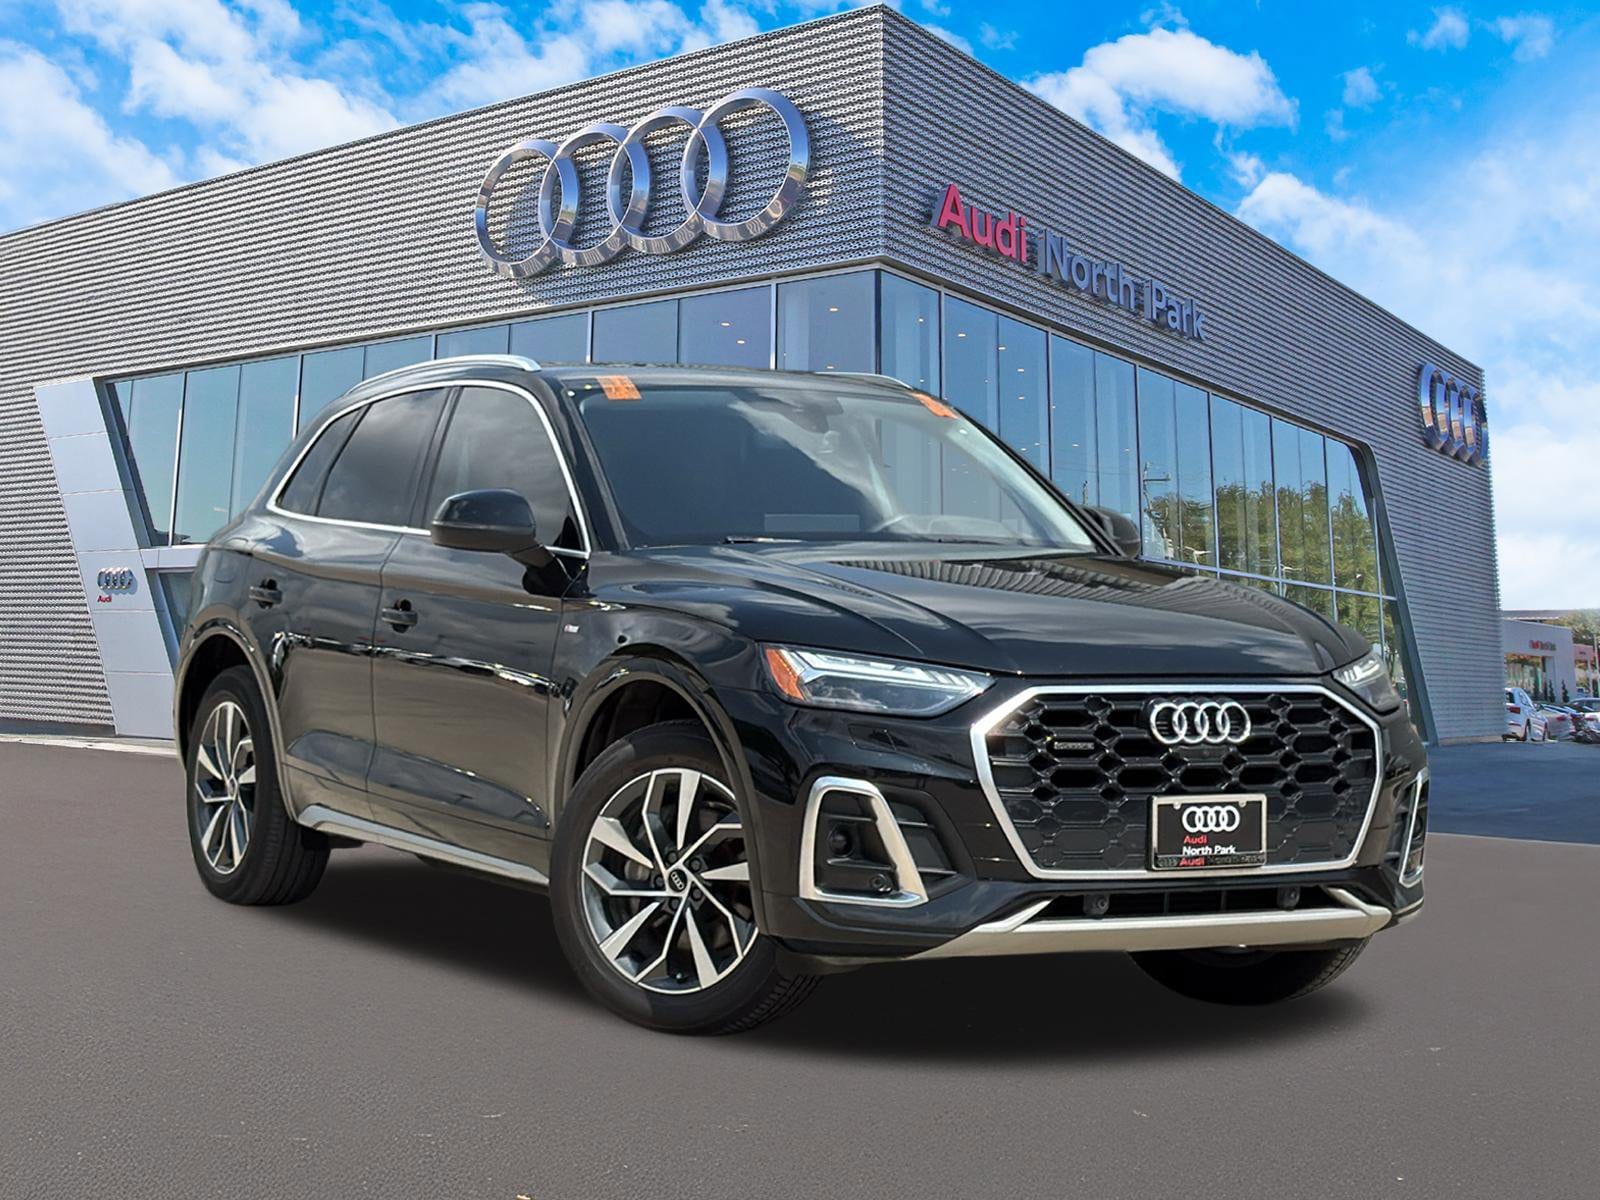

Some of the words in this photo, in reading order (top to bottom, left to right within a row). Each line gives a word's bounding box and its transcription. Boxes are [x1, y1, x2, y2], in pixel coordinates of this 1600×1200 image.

[931, 183, 1028, 264] Audi
[1037, 229, 1136, 310] North
[1144, 278, 1207, 342] Park
[1183, 835, 1207, 844] Audi
[1182, 846, 1212, 856] North
[1214, 845, 1236, 855] Park
[1179, 857, 1205, 867] Audi
